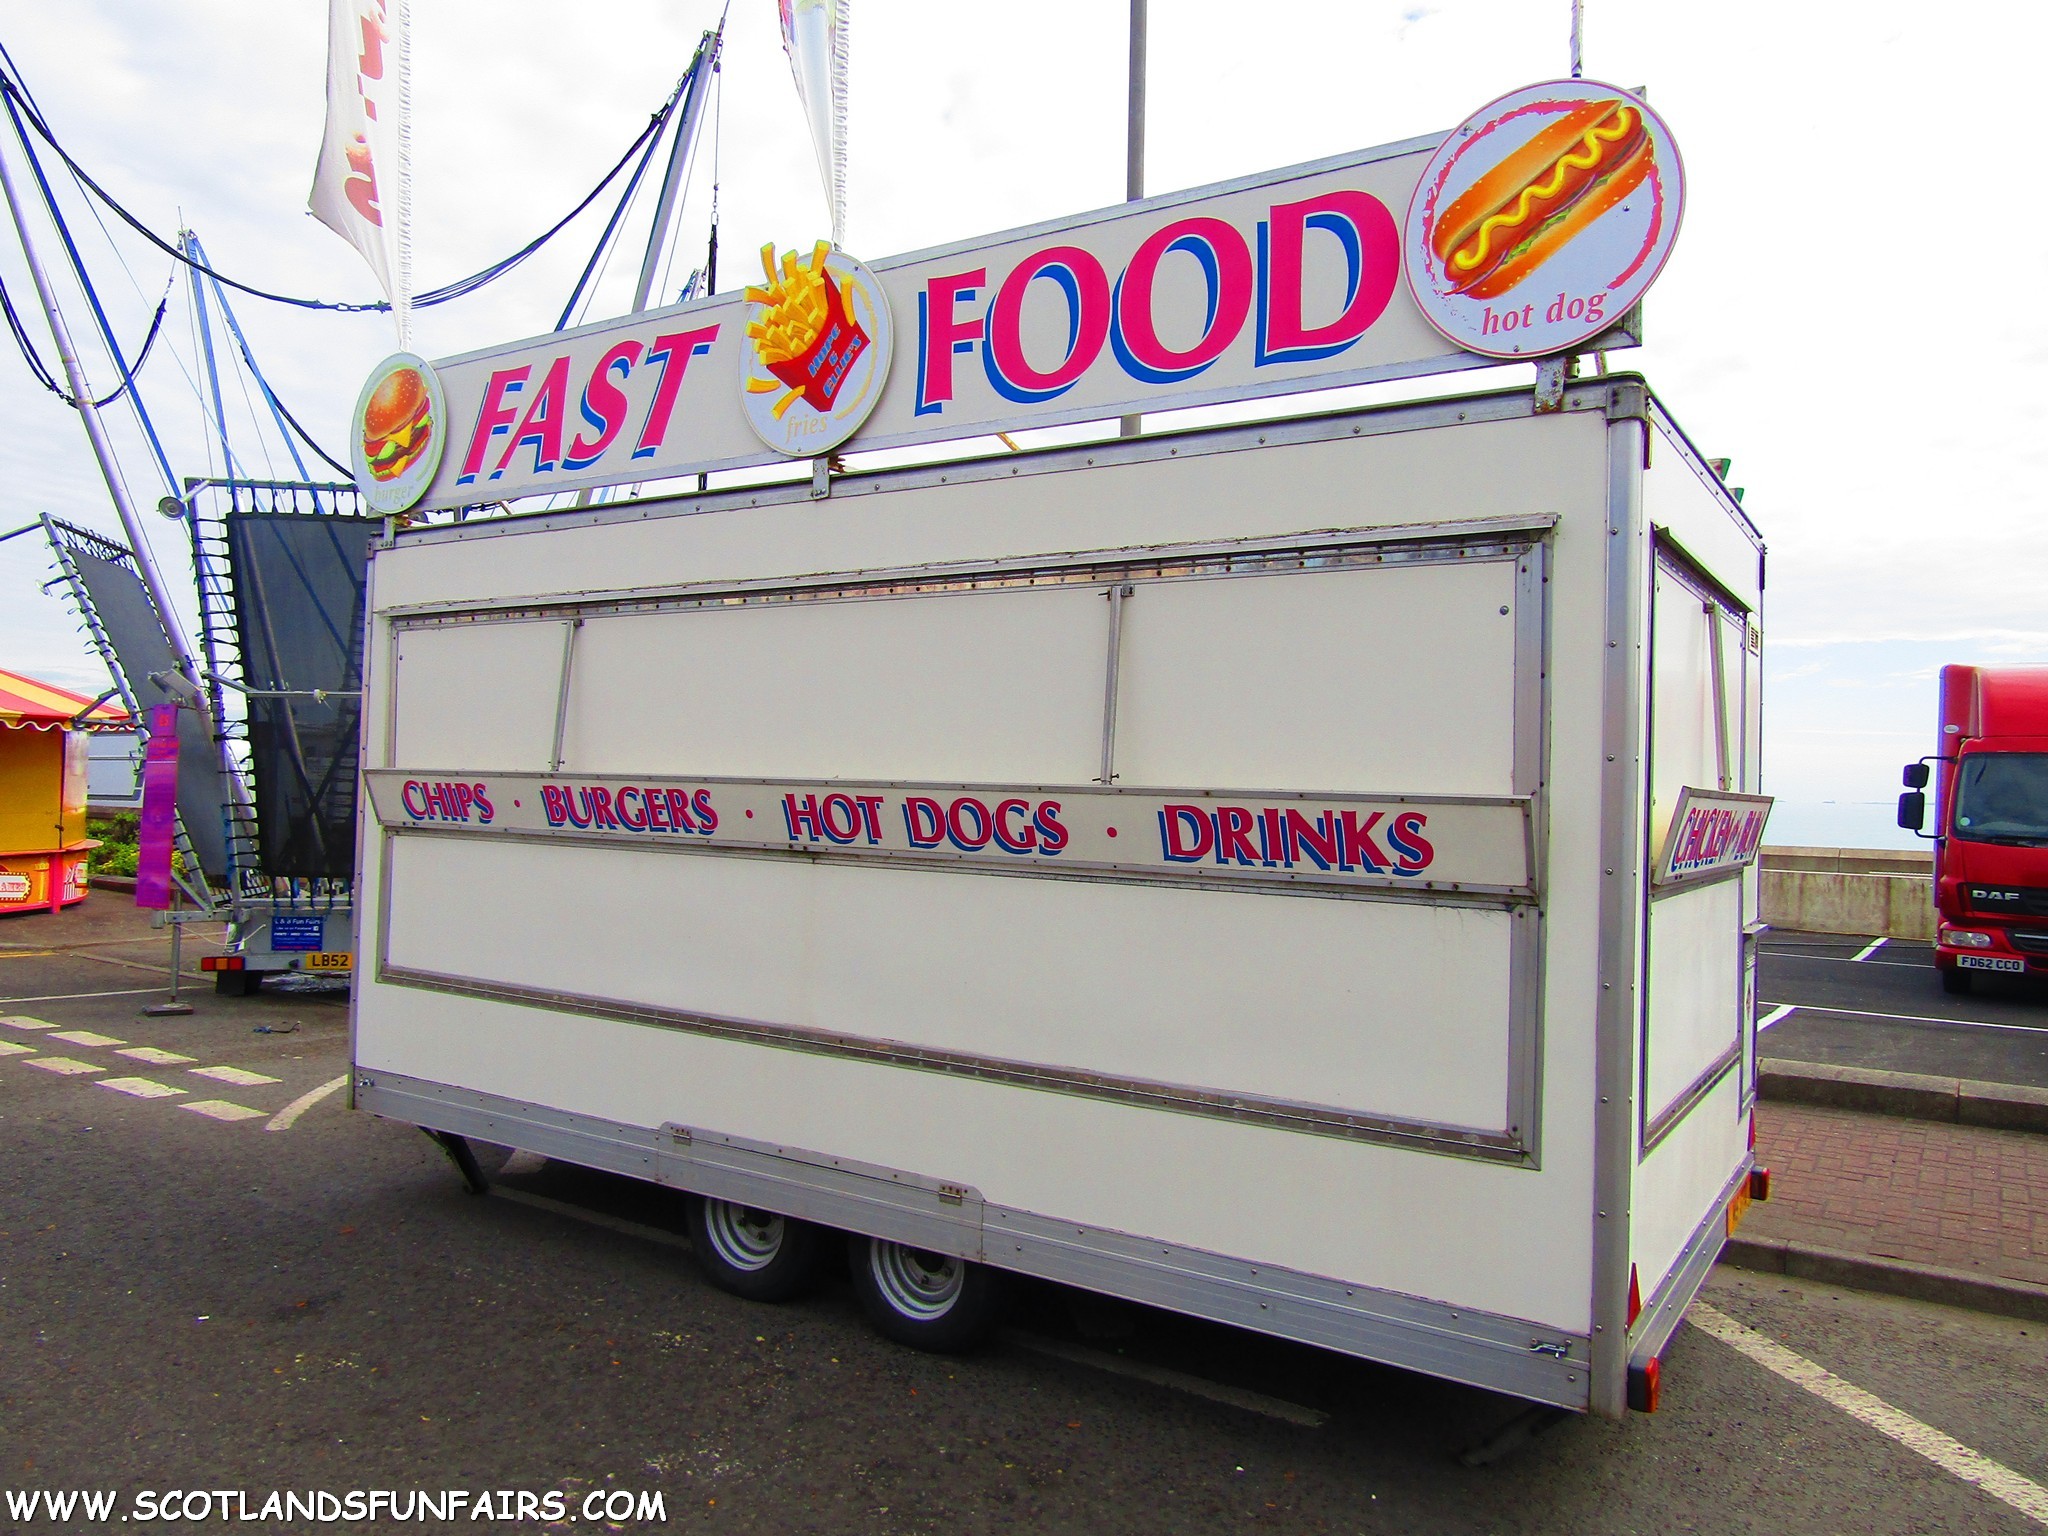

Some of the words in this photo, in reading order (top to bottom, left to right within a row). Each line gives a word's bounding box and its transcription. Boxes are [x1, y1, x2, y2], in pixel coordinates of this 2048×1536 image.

[1481, 302, 1534, 336] hot
[1545, 292, 1609, 324] dog
[456, 323, 720, 486] FAST
[914, 190, 1400, 417] FOOD
[808, 322, 841, 378] HOPE
[823, 334, 862, 398] ELLIE'S
[785, 414, 829, 444] fries
[374, 484, 414, 505] burger
[401, 780, 495, 825] CHIPS
[540, 785, 719, 836] BURGERS
[781, 793, 884, 846] HOT
[901, 796, 1069, 857] DOGS
[1157, 804, 1435, 877] DRINKS
[1671, 807, 1737, 873] CHICKEN
[1971, 889, 2020, 901] DAF
[312, 954, 349, 967] LB52
[1961, 956, 1993, 968] FD62
[1996, 959, 2020, 970] CCO
